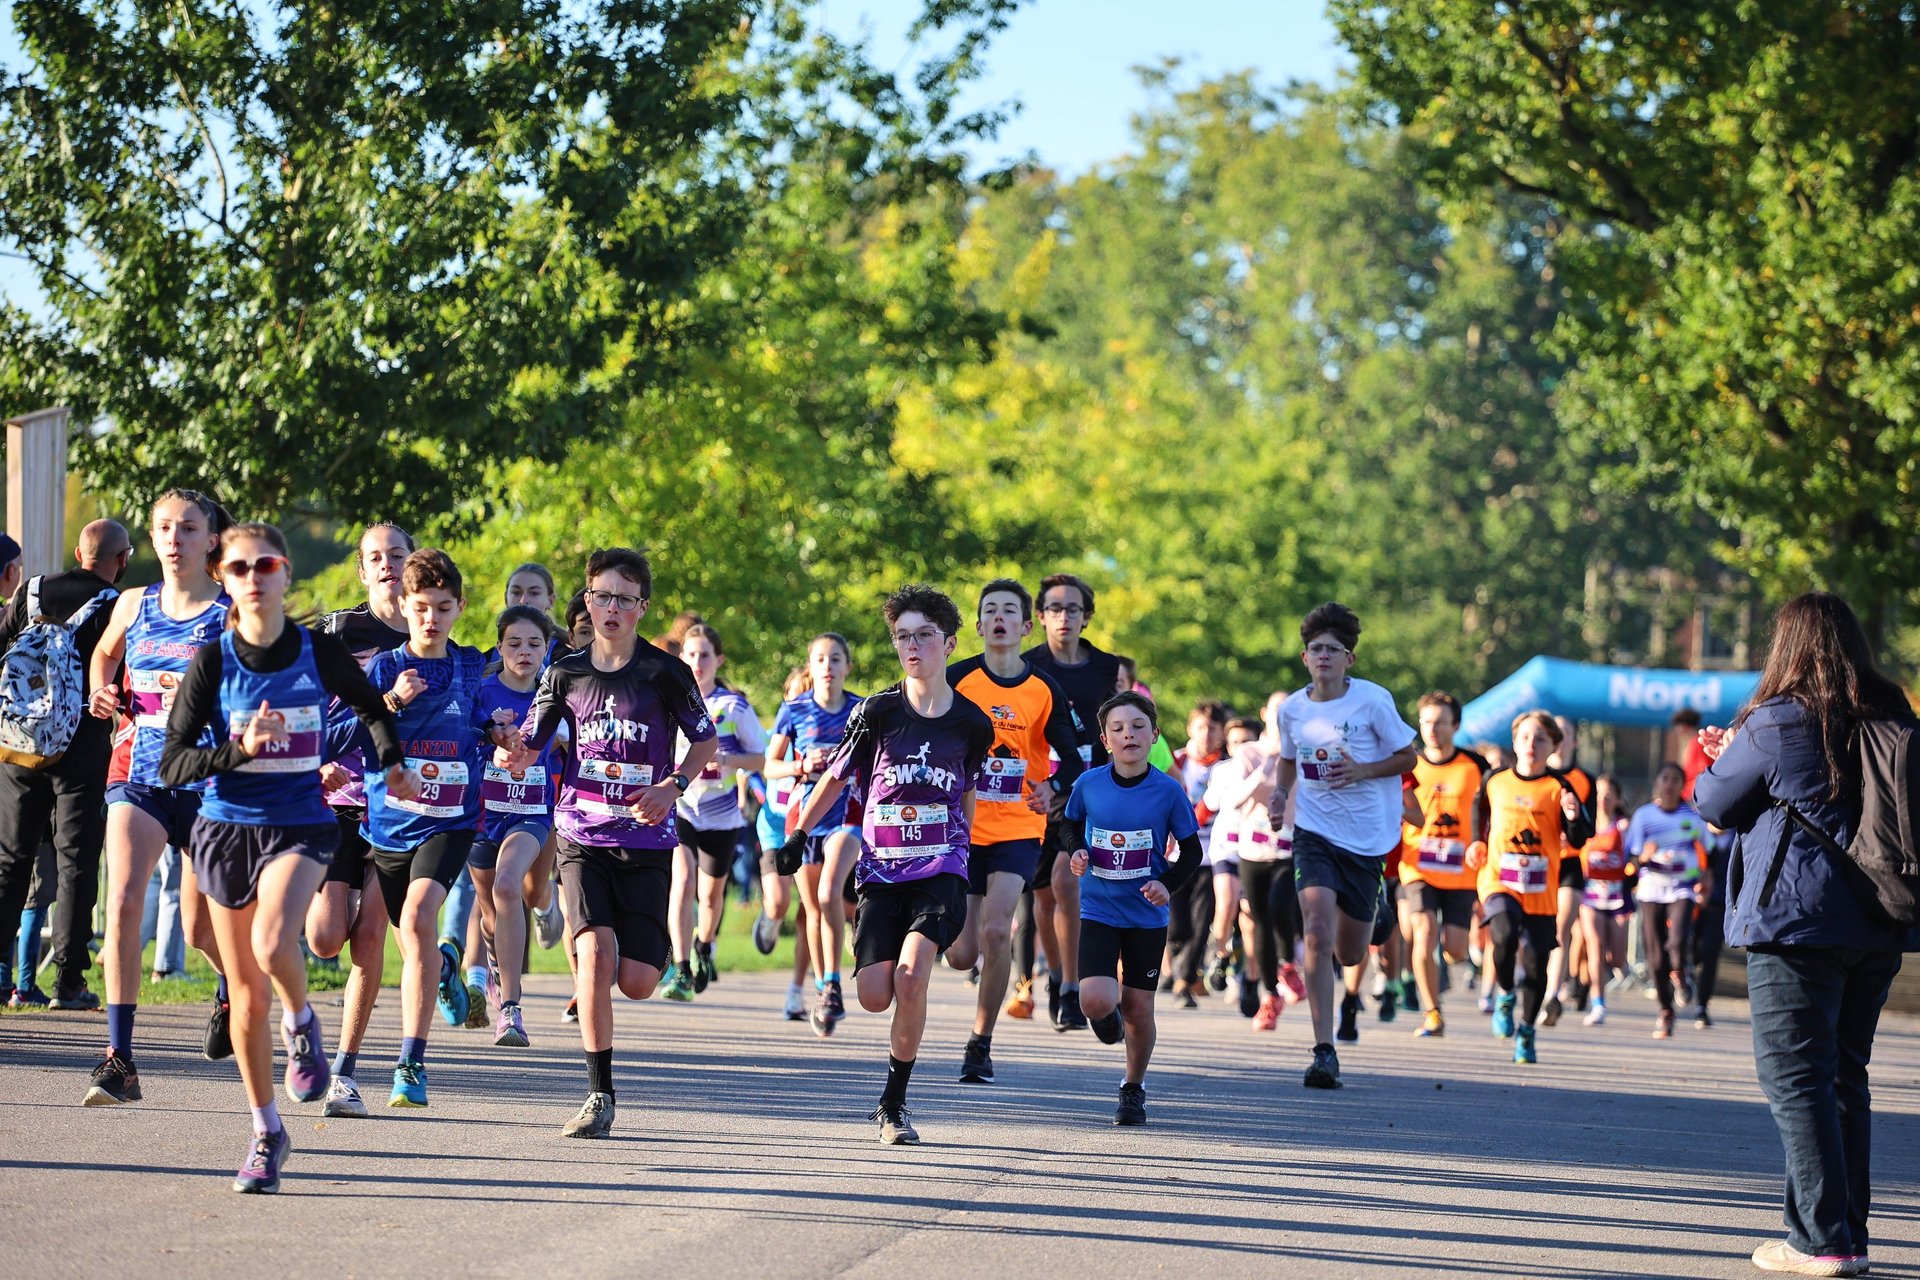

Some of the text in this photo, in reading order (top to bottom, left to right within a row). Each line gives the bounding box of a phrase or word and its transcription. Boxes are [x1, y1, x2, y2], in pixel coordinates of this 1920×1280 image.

[136, 640, 155, 655] AS
[1608, 671, 1722, 712] Nord
[408, 740, 459, 758] ANZIN
[988, 775, 1003, 789] 45
[506, 784, 526, 799] 104
[602, 782, 624, 800] 144
[899, 825, 922, 841] 145
[1112, 850, 1126, 866] 37
